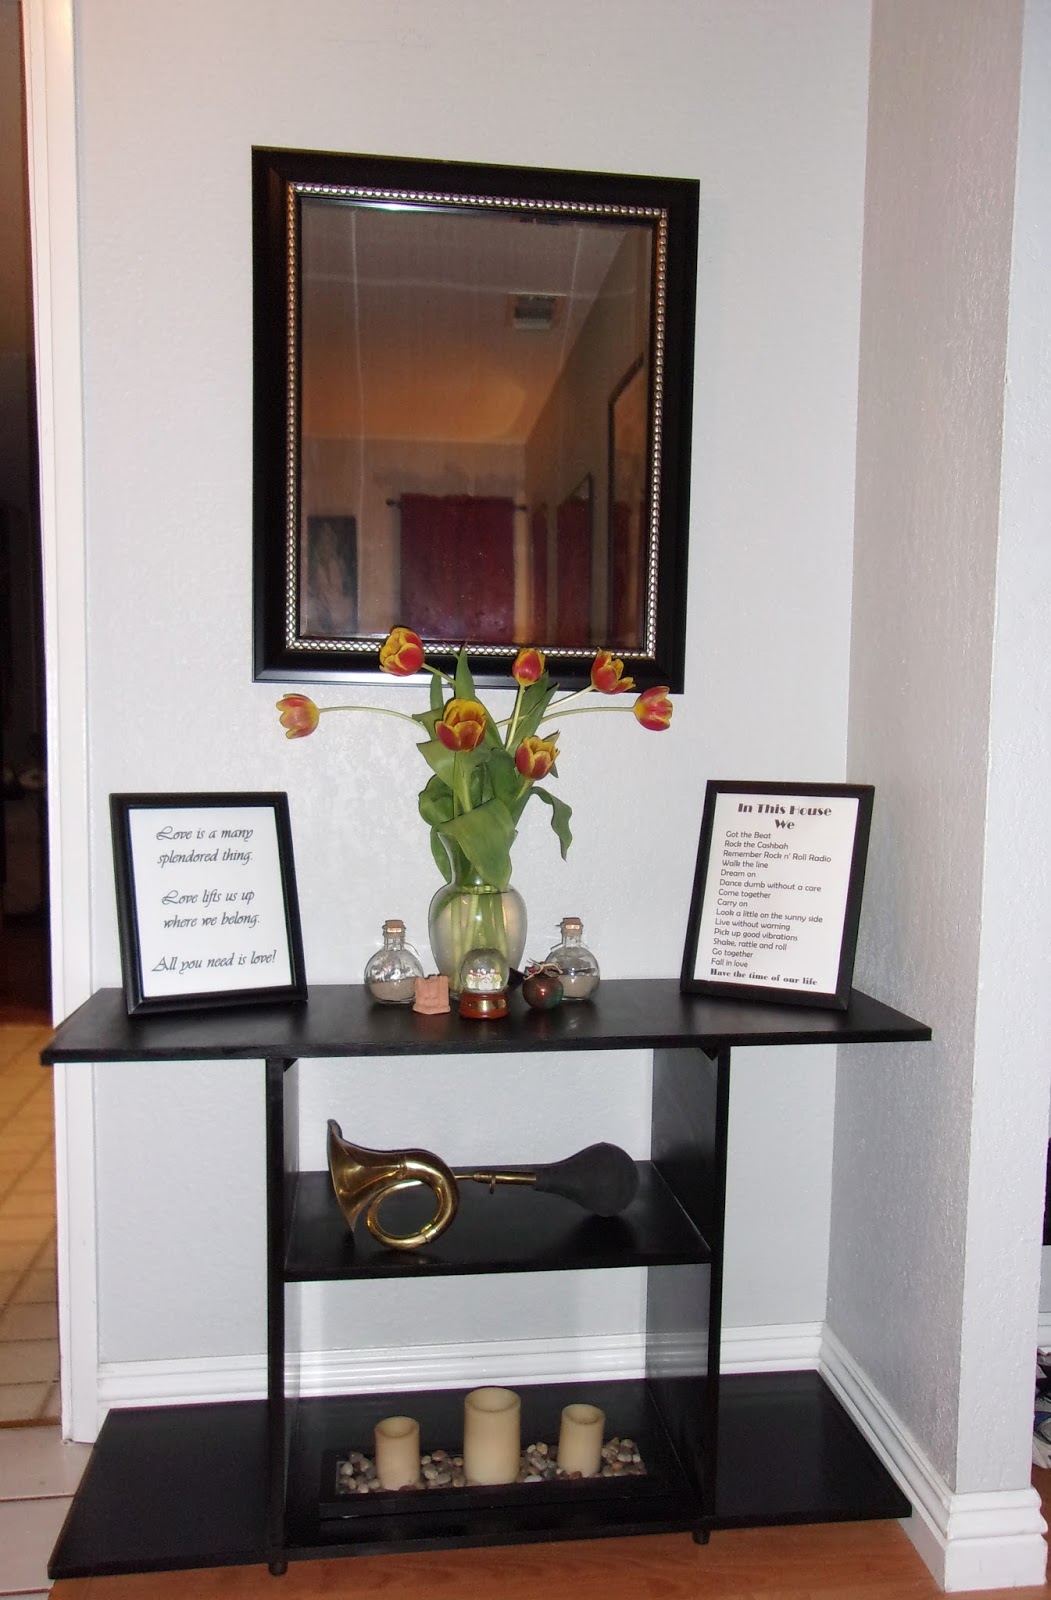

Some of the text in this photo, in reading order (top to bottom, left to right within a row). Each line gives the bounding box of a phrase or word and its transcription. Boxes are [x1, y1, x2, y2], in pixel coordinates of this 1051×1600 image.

[738, 803, 832, 816] In This House
[775, 819, 794, 830] We
[156, 826, 253, 842] Love is a many
[757, 842, 788, 850] Cashbah
[157, 849, 253, 868] splendored thing.
[723, 850, 762, 858] Remember
[793, 853, 807, 861] Roll
[720, 879, 742, 887] Dance
[744, 880, 765, 888] dumb
[767, 881, 795, 890] without
[162, 889, 254, 907] Love lifts us up
[741, 891, 771, 899] together
[717, 899, 736, 907] Carry
[164, 911, 260, 928] where we belong.
[742, 910, 758, 918] little
[771, 912, 782, 920] the
[784, 914, 807, 923] sunny
[808, 915, 823, 923] side
[715, 918, 790, 931] Live without warning
[714, 928, 729, 936] Pick
[743, 930, 760, 939] good
[762, 931, 798, 941] vibrations
[713, 938, 736, 947] Shake,
[738, 940, 757, 948] rattle
[759, 941, 774, 949] and
[712, 948, 753, 958] Go together
[152, 950, 276, 974] All you need is love!
[711, 958, 724, 966] Fall
[734, 960, 748, 968] love
[710, 968, 731, 977] Have
[749, 972, 768, 980] time
[802, 977, 818, 985] life
